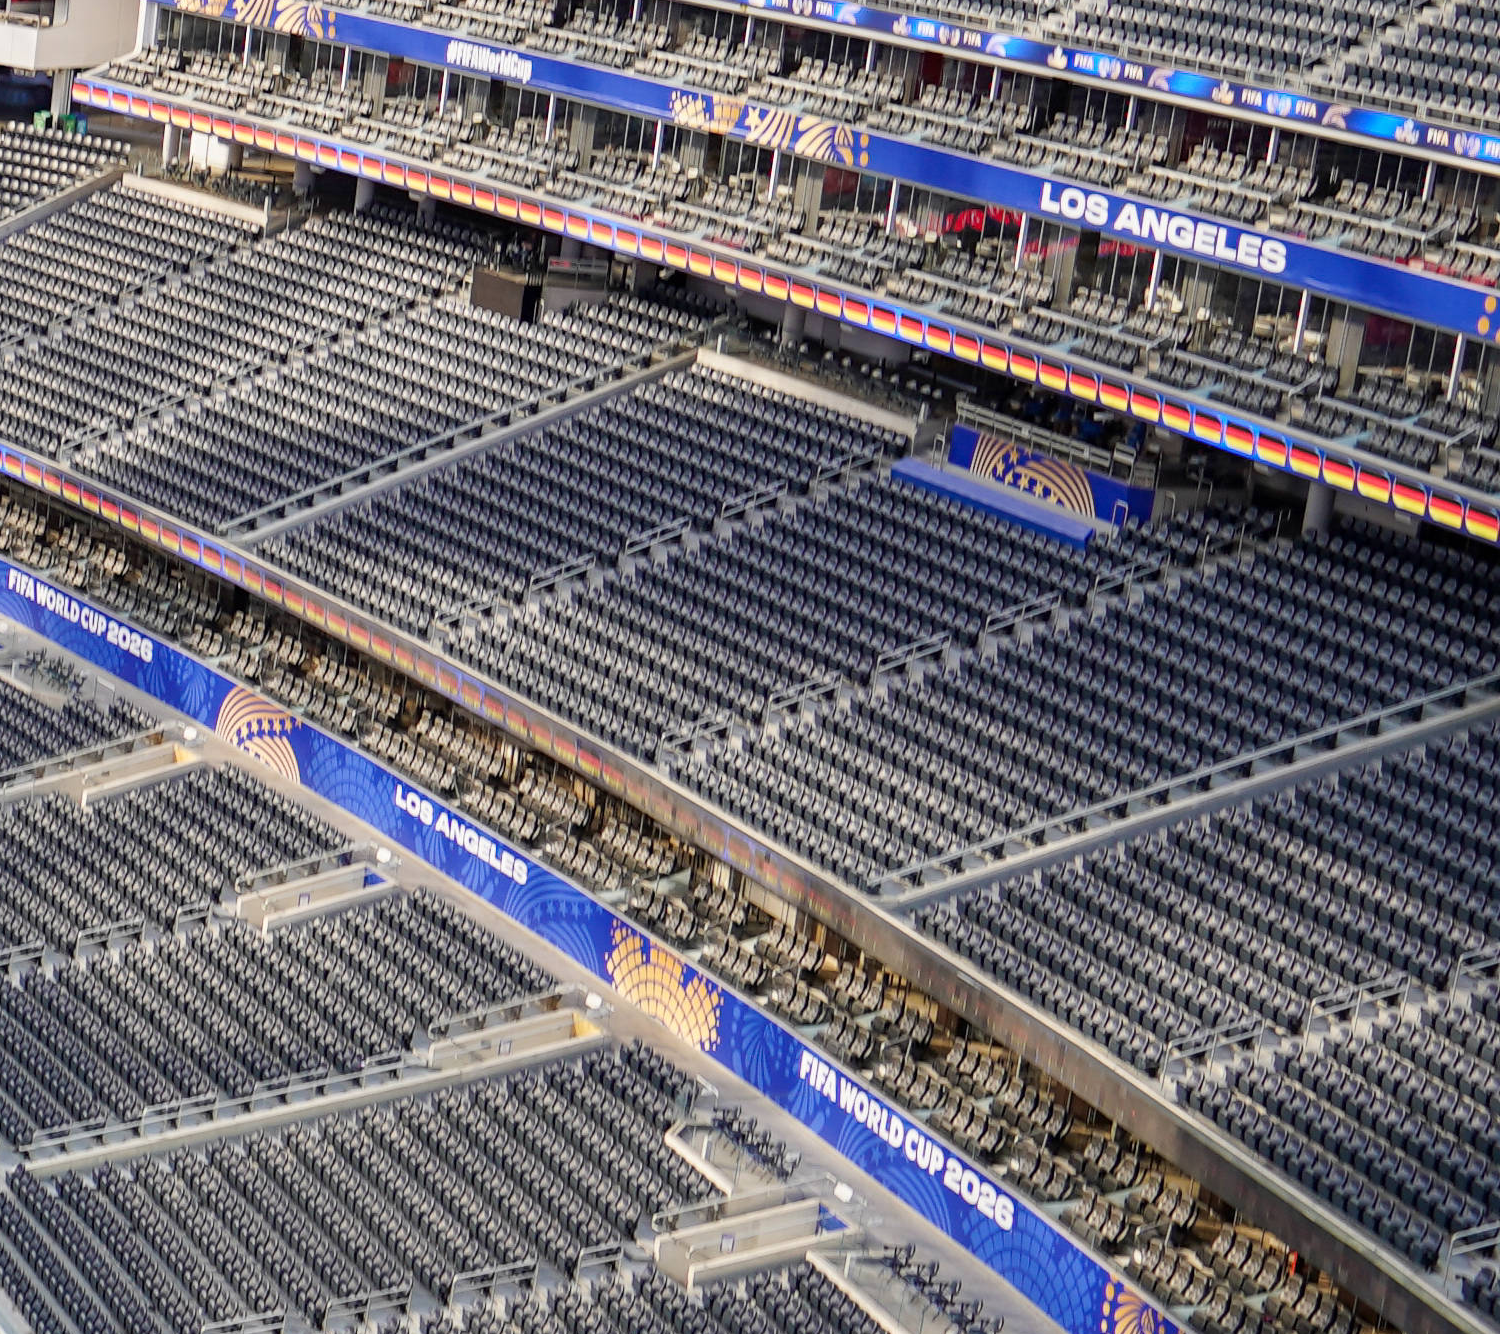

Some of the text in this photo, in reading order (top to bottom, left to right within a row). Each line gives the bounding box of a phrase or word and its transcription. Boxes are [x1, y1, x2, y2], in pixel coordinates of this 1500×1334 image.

[447, 39, 531, 84] #FIFAWorldCup
[1040, 181, 1286, 275] LOS ANGELES
[9, 568, 153, 662] FIFA WORLD CUP 2026
[395, 784, 527, 885] LOS ANGELES
[800, 1050, 1012, 1230] FIFA WORLD CUP 2026
